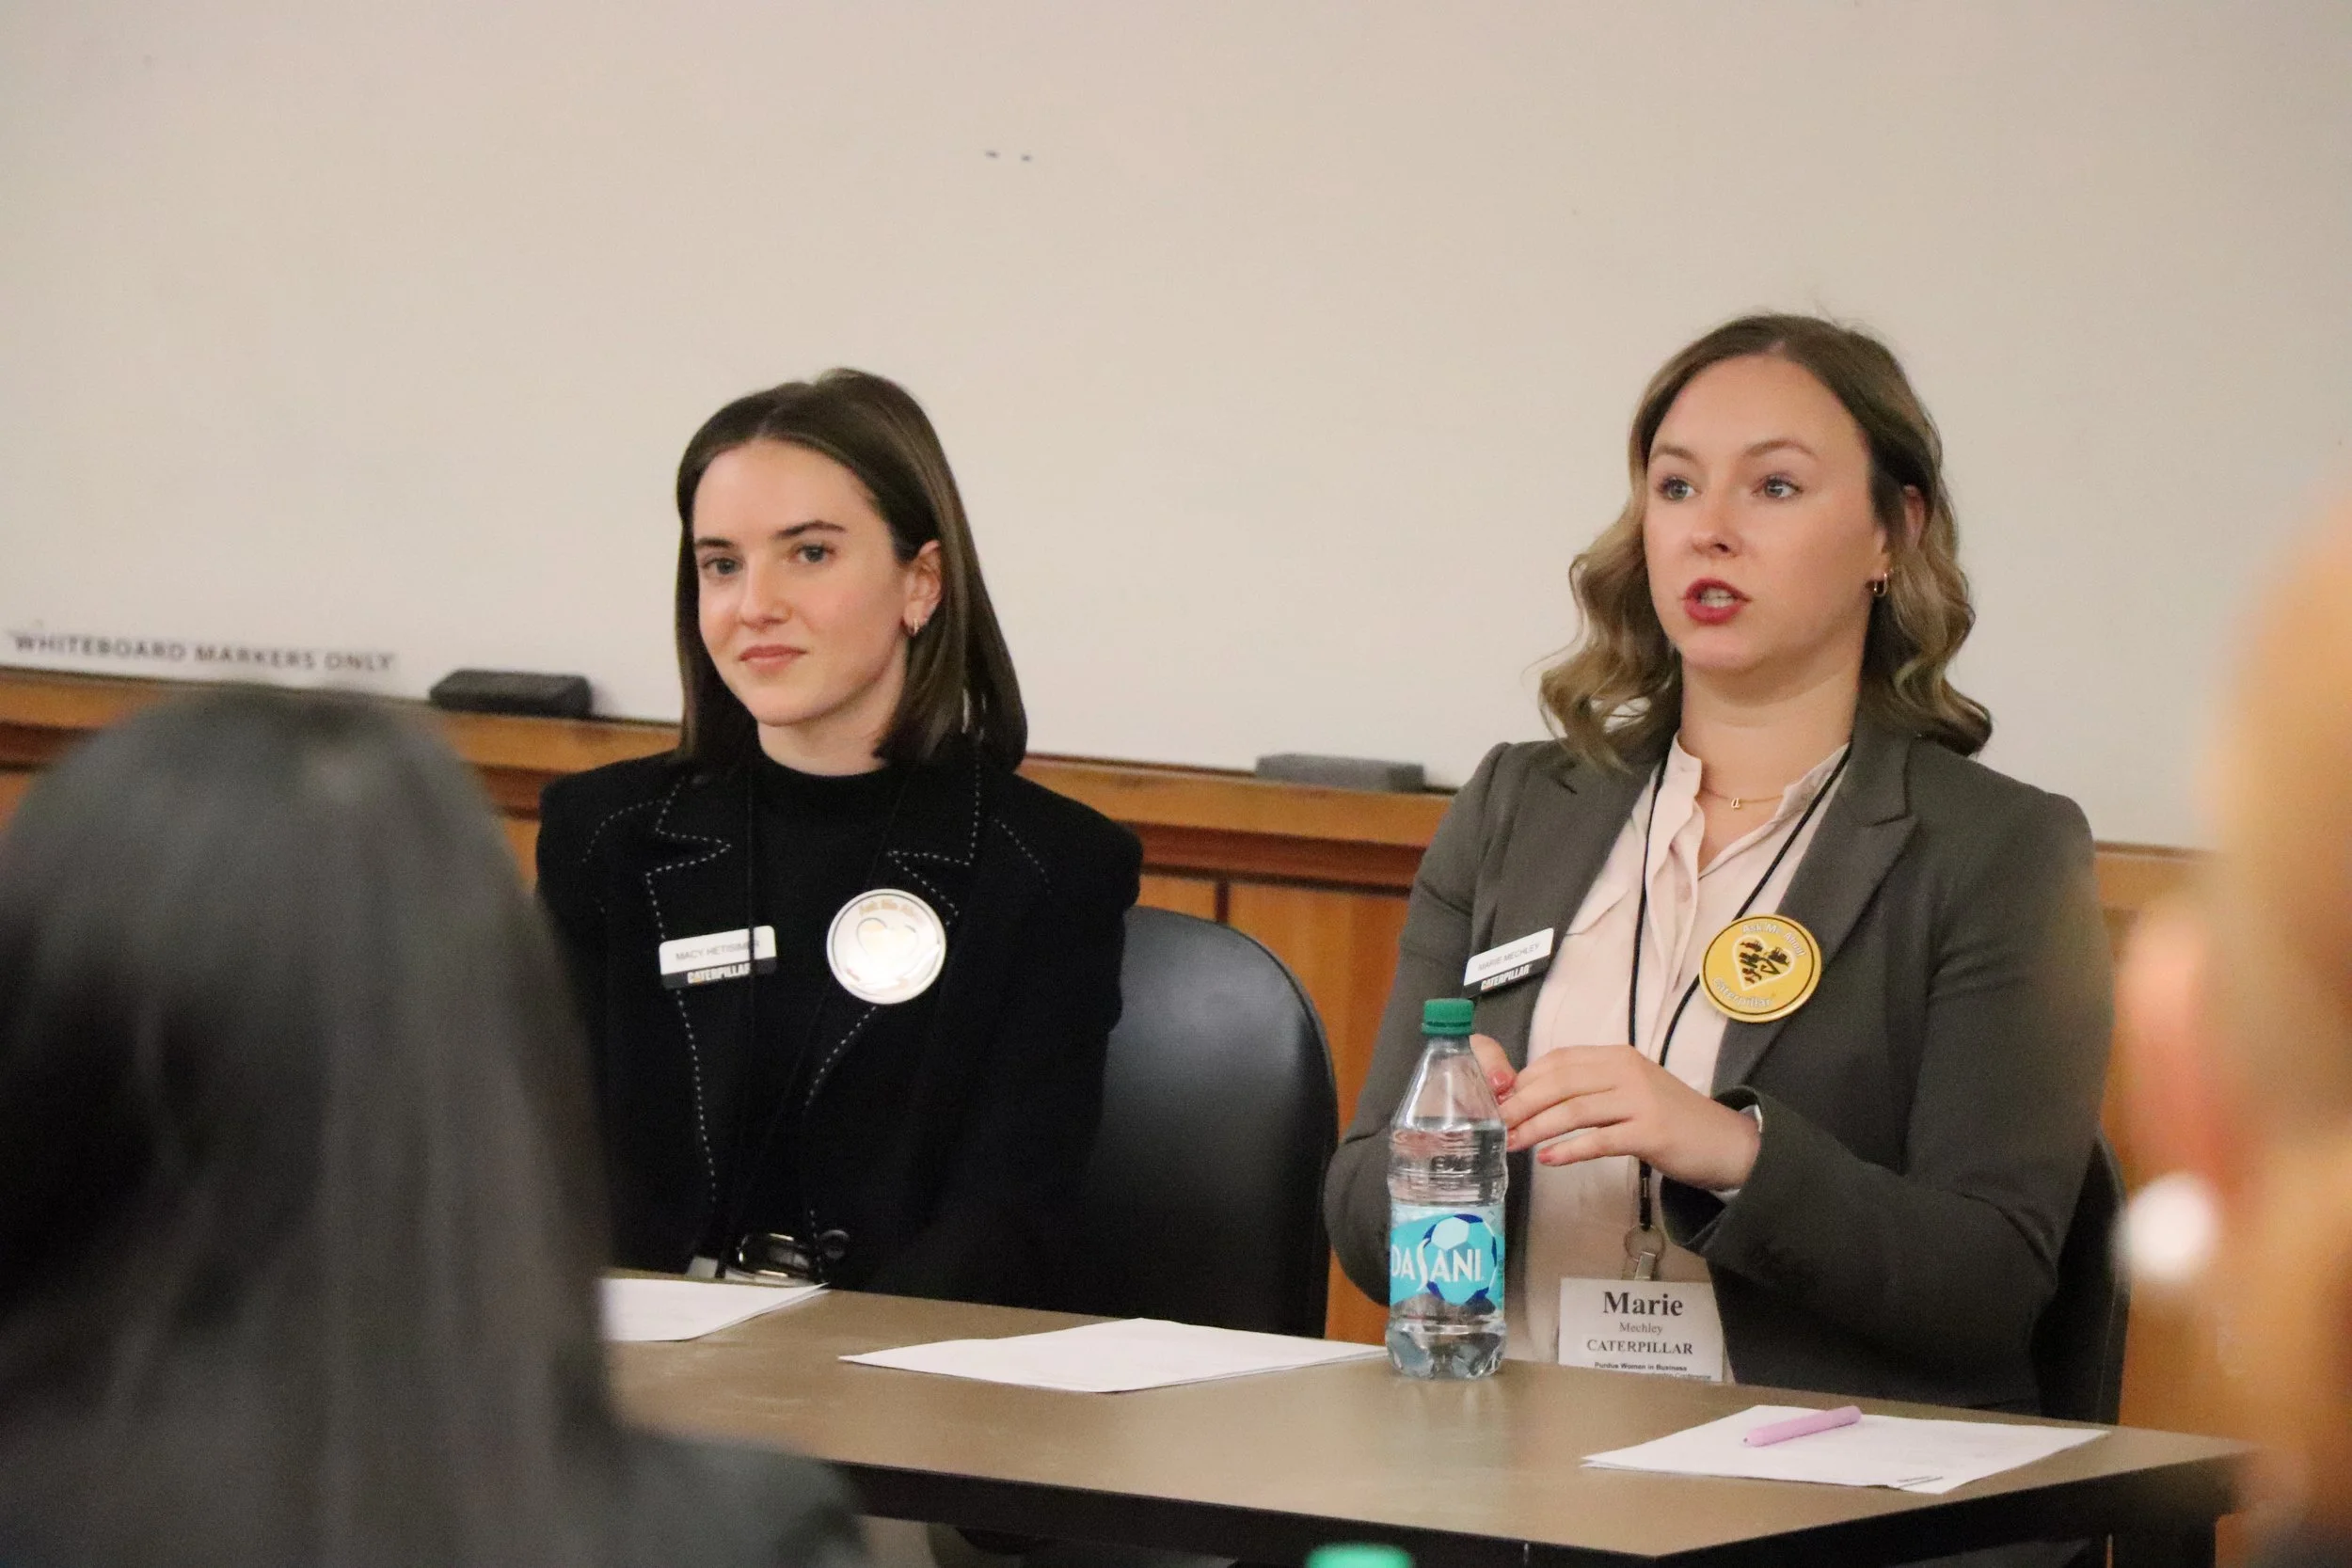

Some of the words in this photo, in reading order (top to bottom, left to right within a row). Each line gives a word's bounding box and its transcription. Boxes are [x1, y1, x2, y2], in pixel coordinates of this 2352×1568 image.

[14, 635, 187, 662] WHITEBOARD
[194, 643, 315, 672] MARKERS
[324, 651, 395, 673] ONLY
[1741, 924, 1762, 934] Ask
[1503, 943, 1540, 961] MECHLEY
[1480, 964, 1531, 991] CATERPILLAR
[1391, 1238, 1482, 1292] DASANI
[1602, 1291, 1684, 1317] Marie
[1618, 1322, 1663, 1336] Mechley
[1586, 1338, 1693, 1355] CATERPILLAR
[1621, 1362, 1646, 1370] Women
